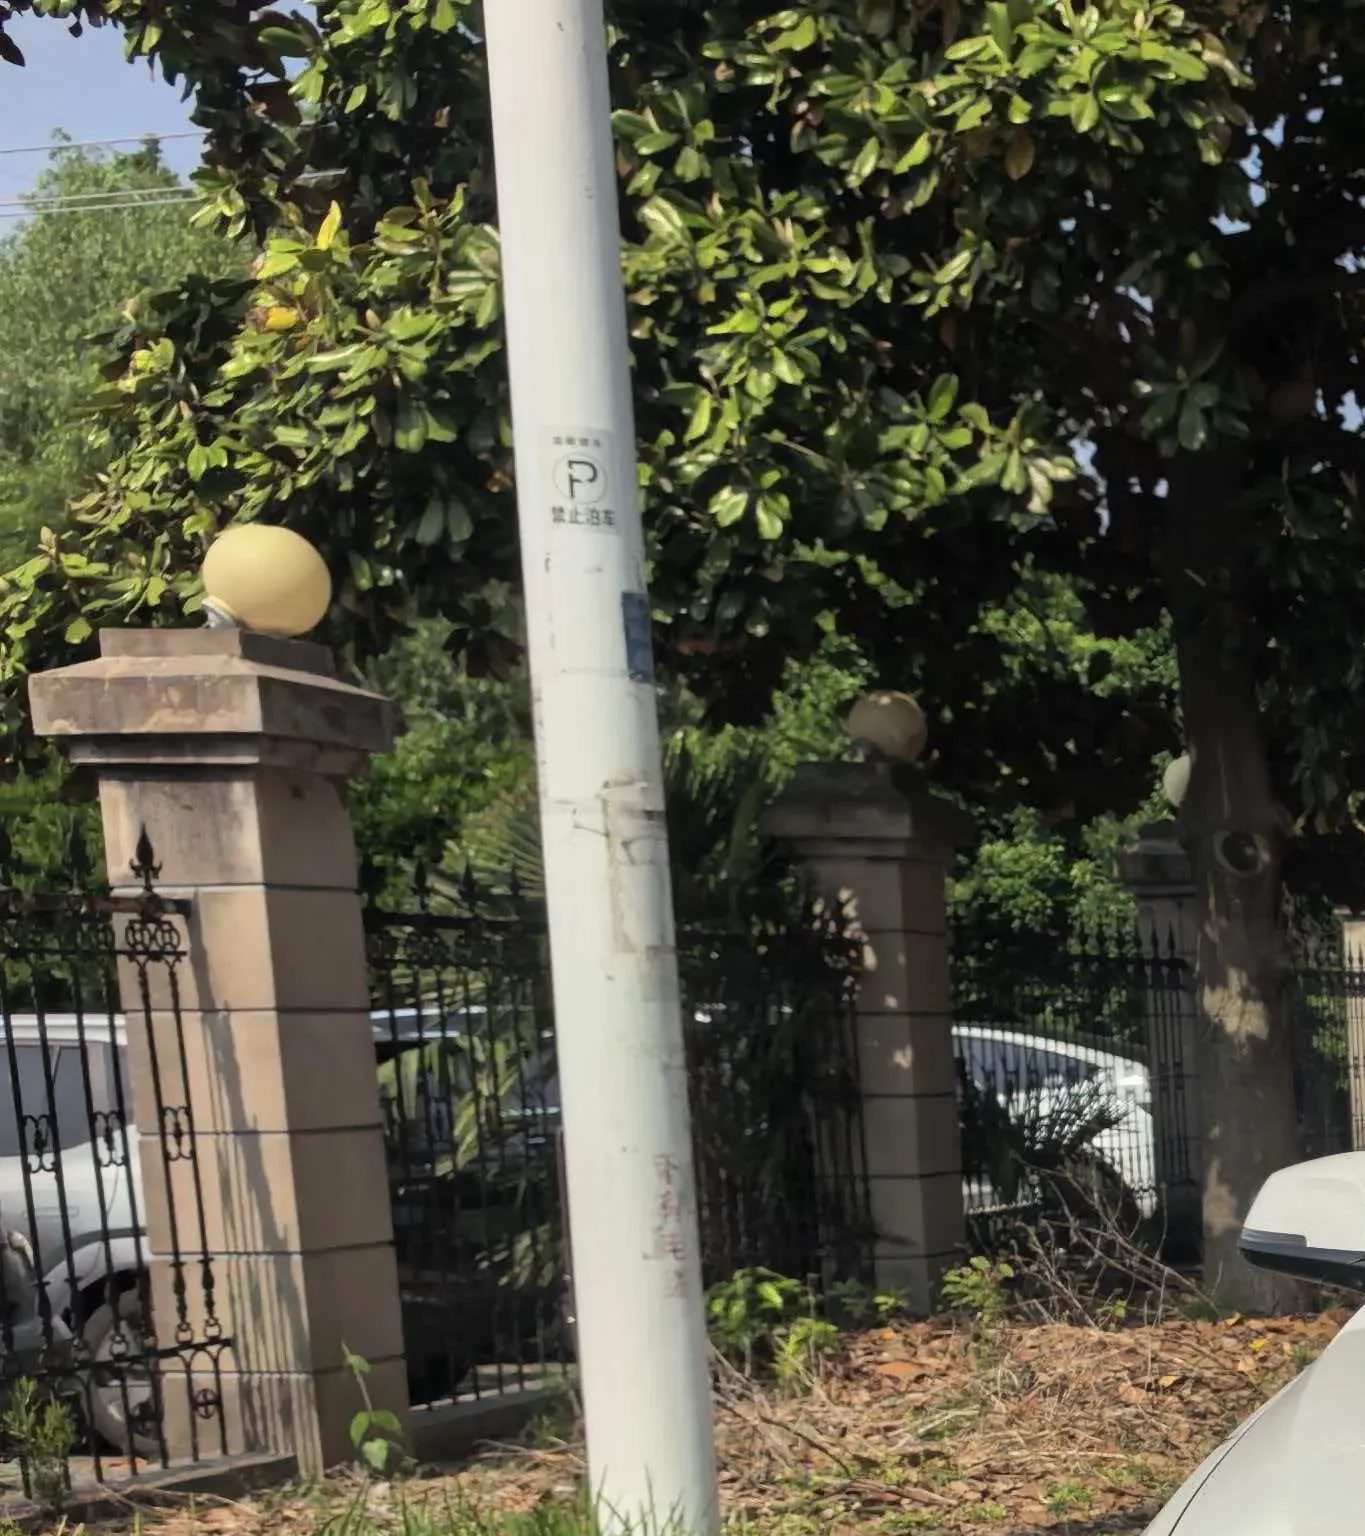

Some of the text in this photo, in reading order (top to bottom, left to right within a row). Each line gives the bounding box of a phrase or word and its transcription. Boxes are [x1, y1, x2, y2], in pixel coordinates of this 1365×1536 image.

[567, 459, 598, 499] P
[551, 504, 616, 526] 禁止泊车
